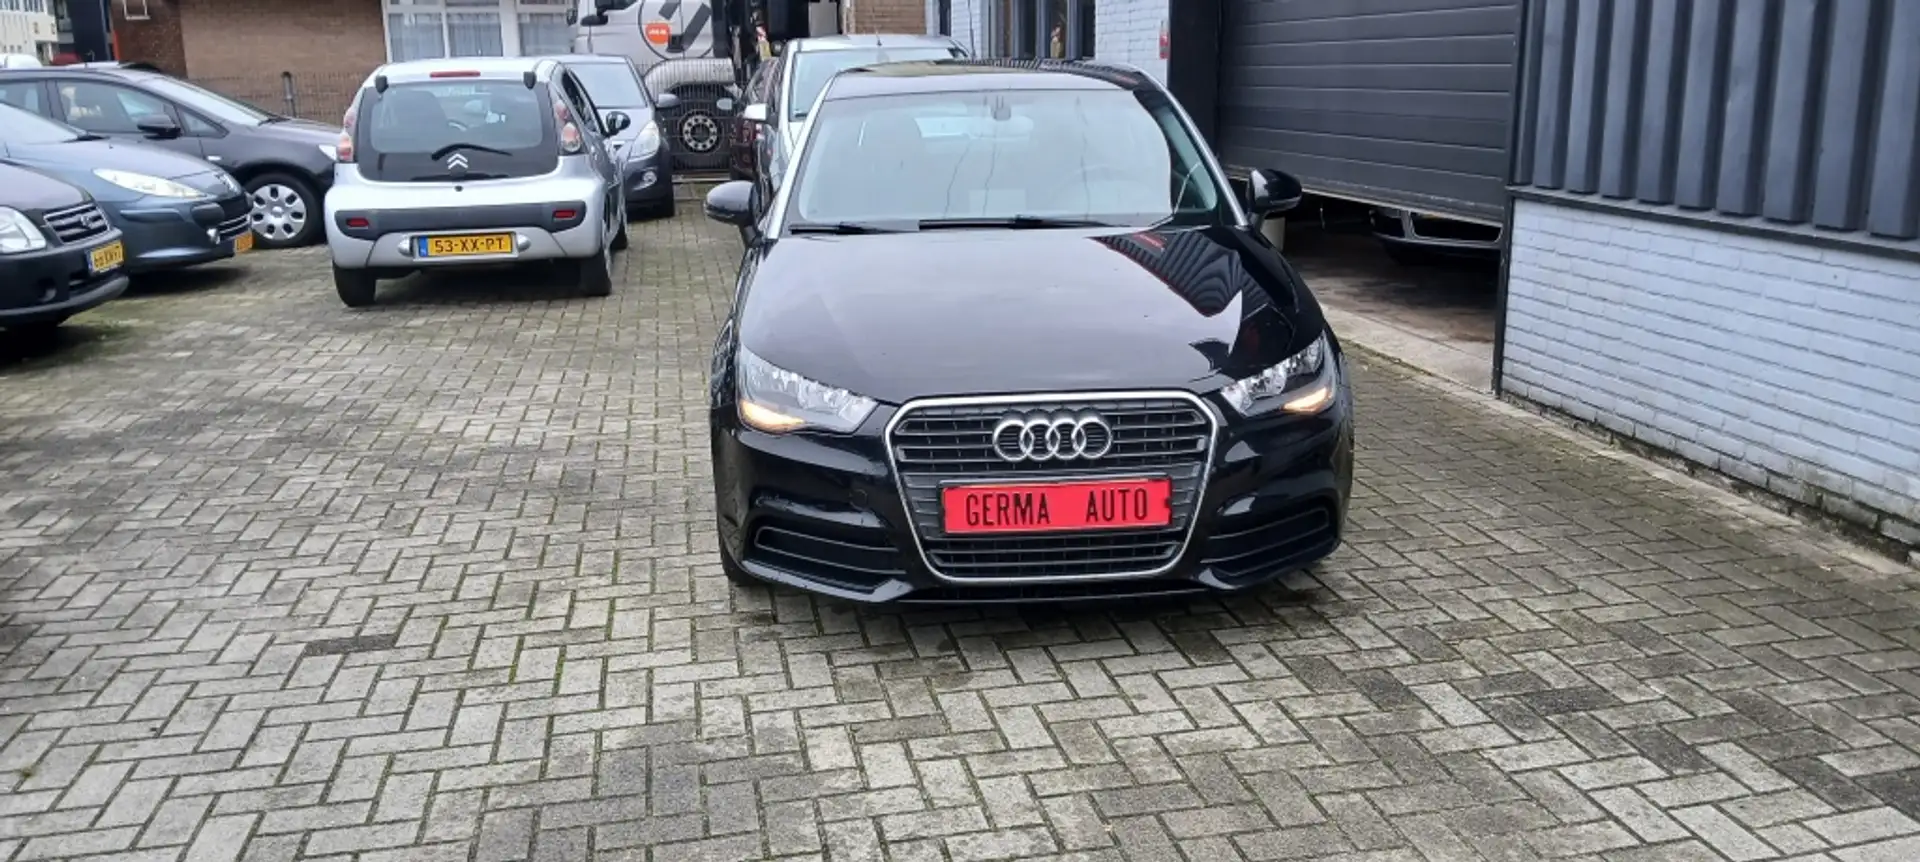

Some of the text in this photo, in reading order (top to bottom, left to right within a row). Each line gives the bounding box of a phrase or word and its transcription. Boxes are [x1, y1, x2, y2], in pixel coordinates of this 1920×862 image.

[434, 237, 504, 253] 53-XX-PT
[966, 488, 1147, 526] GERMA AUTO
